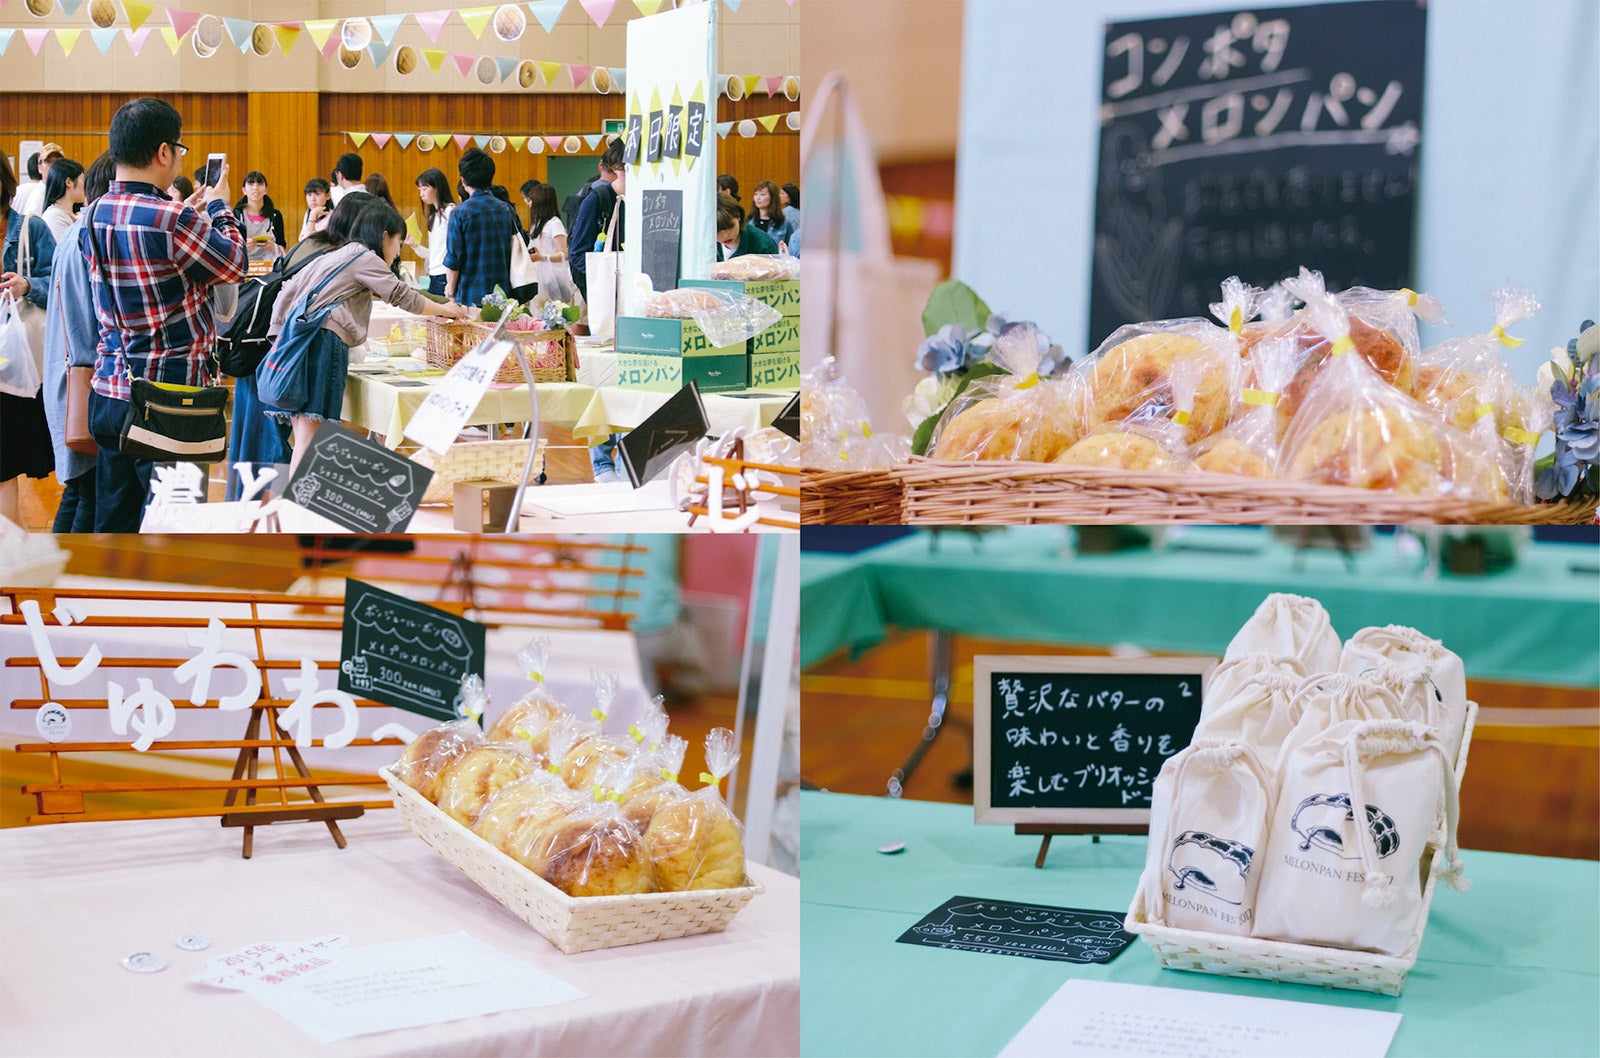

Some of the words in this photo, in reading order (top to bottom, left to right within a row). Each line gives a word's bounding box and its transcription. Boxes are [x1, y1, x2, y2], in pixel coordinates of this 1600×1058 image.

[1106, 12, 1291, 98] コンポタ
[1150, 72, 1403, 149] メロンパン
[625, 109, 702, 158] 本日限定
[643, 192, 667, 213] コンポタ
[649, 213, 679, 229] メロンパン
[618, 366, 681, 385] メロンパン
[324, 489, 343, 504] 300
[379, 666, 402, 683] 300
[997, 678, 1165, 719] 贅沢なバターの
[1005, 722, 1177, 756] 味わいと香りを
[1007, 761, 1156, 797] 楽しむブリオッシ
[1282, 854, 1343, 880] MELONPAN
[962, 933, 1000, 943] 550
[1003, 940, 1026, 949] yen
[970, 922, 1064, 938] メロンパン
